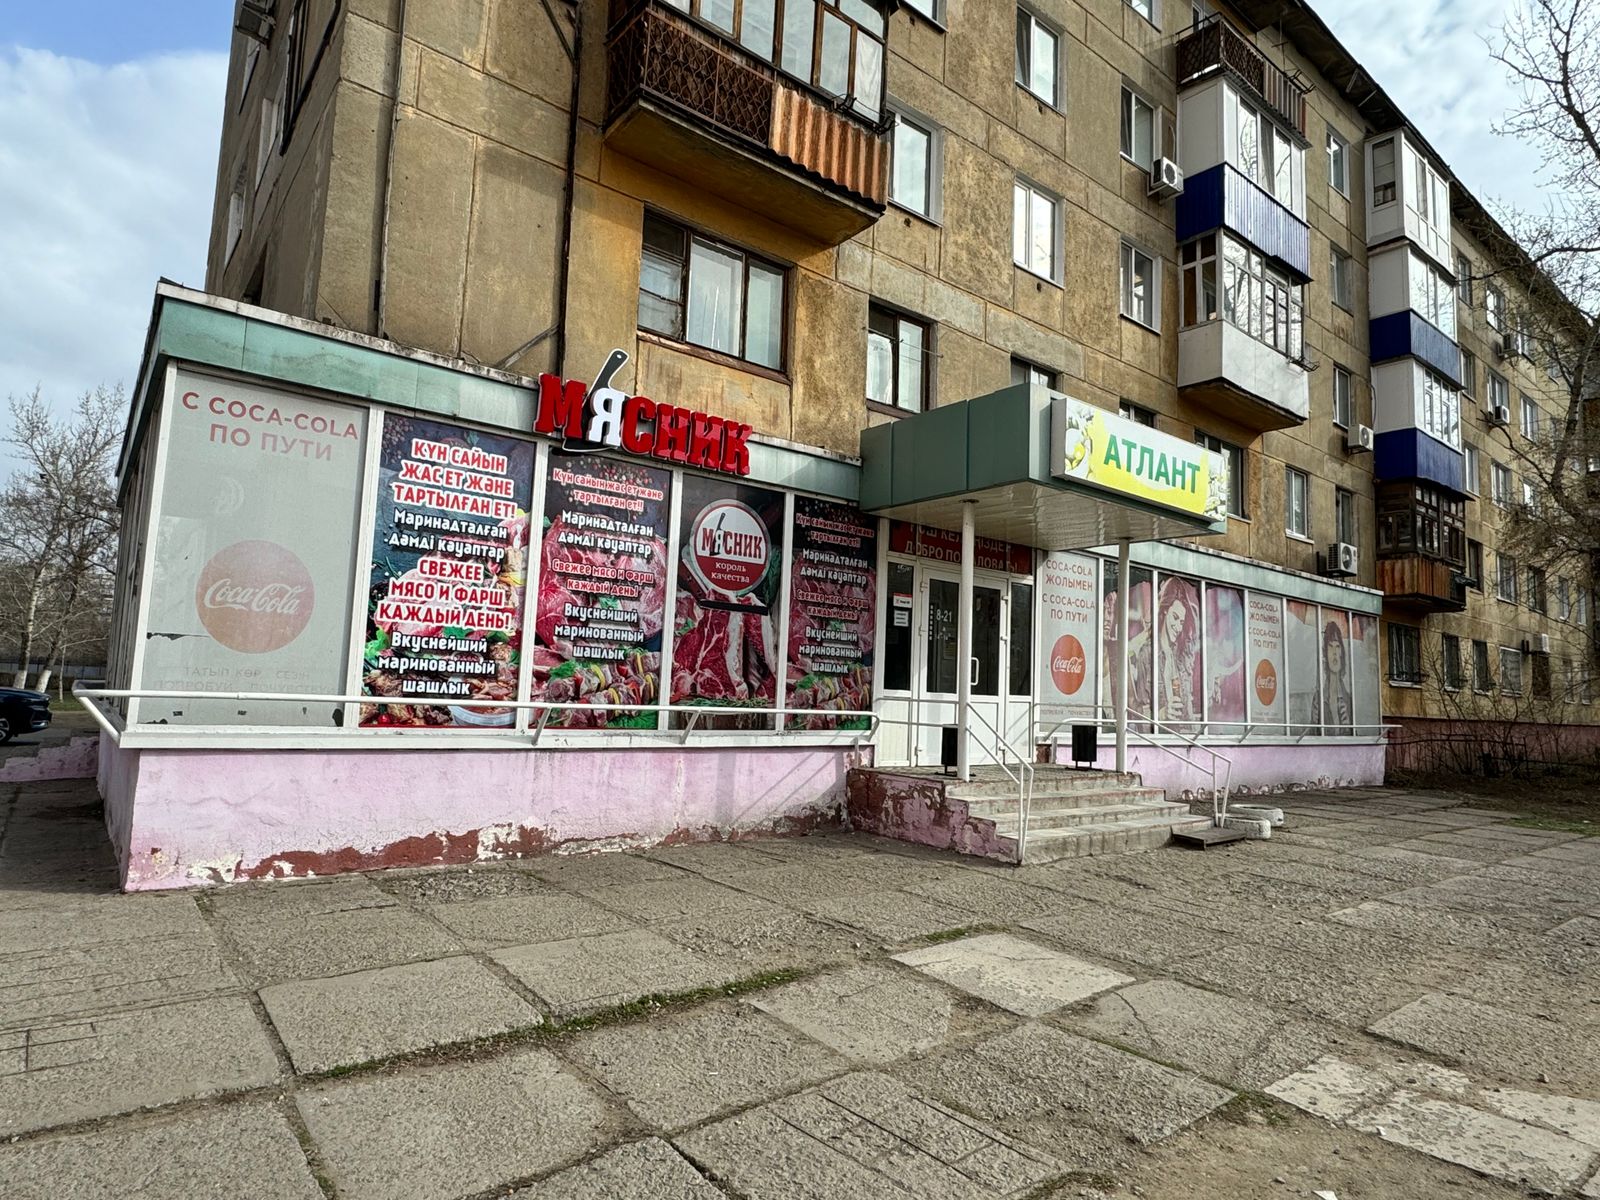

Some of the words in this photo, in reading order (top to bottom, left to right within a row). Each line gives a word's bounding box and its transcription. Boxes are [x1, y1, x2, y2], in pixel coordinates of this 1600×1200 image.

[182, 391, 199, 409] С
[208, 396, 358, 440] COCA-COLA
[533, 372, 753, 475] МЯСНИК
[209, 423, 250, 447] ПО
[261, 432, 332, 461] ПУТИ
[412, 438, 448, 462] КҮН
[451, 447, 507, 474] САЙЫН
[1103, 434, 1200, 494] АТЛАНТ
[401, 461, 441, 483] ЖАС
[445, 470, 464, 489] ЕТ
[465, 474, 513, 498] ЖӘНЕ
[393, 483, 491, 515] ТАРТЫЛҒАН
[492, 501, 516, 519] ЕТ!
[394, 508, 507, 539] Маринадталған
[562, 510, 653, 537] Маринадталған
[438, 539, 505, 563] кәуаптар
[597, 538, 651, 558] кәуаптар
[701, 527, 762, 559] МЯСНИК
[715, 562, 746, 573] король
[802, 548, 868, 568] Маринадталған
[1046, 560, 1092, 576] COCA-COLA
[418, 558, 484, 582] СВЕЖЕЕ
[552, 559, 591, 575] Свежее
[592, 566, 616, 579] мясо
[625, 570, 654, 584] фарш
[711, 572, 750, 583] качества
[390, 578, 435, 600] МЯСО
[438, 585, 450, 602] И
[453, 586, 505, 607] ФАРШ
[566, 579, 610, 594] каждый
[611, 585, 638, 597] день!
[1046, 573, 1093, 591] ЖОЛЫМЕН
[564, 602, 638, 623] Вкуснейший
[1050, 594, 1095, 610] COCA-COLA
[378, 602, 462, 627] КАЖДЫЙ
[463, 612, 511, 631] ДЕНЬ!
[1050, 608, 1063, 620] ПО
[1066, 610, 1088, 623] ПУТИ
[392, 632, 487, 653] Вкуснейший
[554, 625, 644, 642] маринованный
[805, 626, 858, 642] Вкуснейший
[573, 645, 625, 660] шашлык
[799, 645, 862, 658] маринованный
[378, 656, 495, 674] маринованный
[812, 662, 849, 674] шашлык
[402, 680, 470, 695] шашлык
